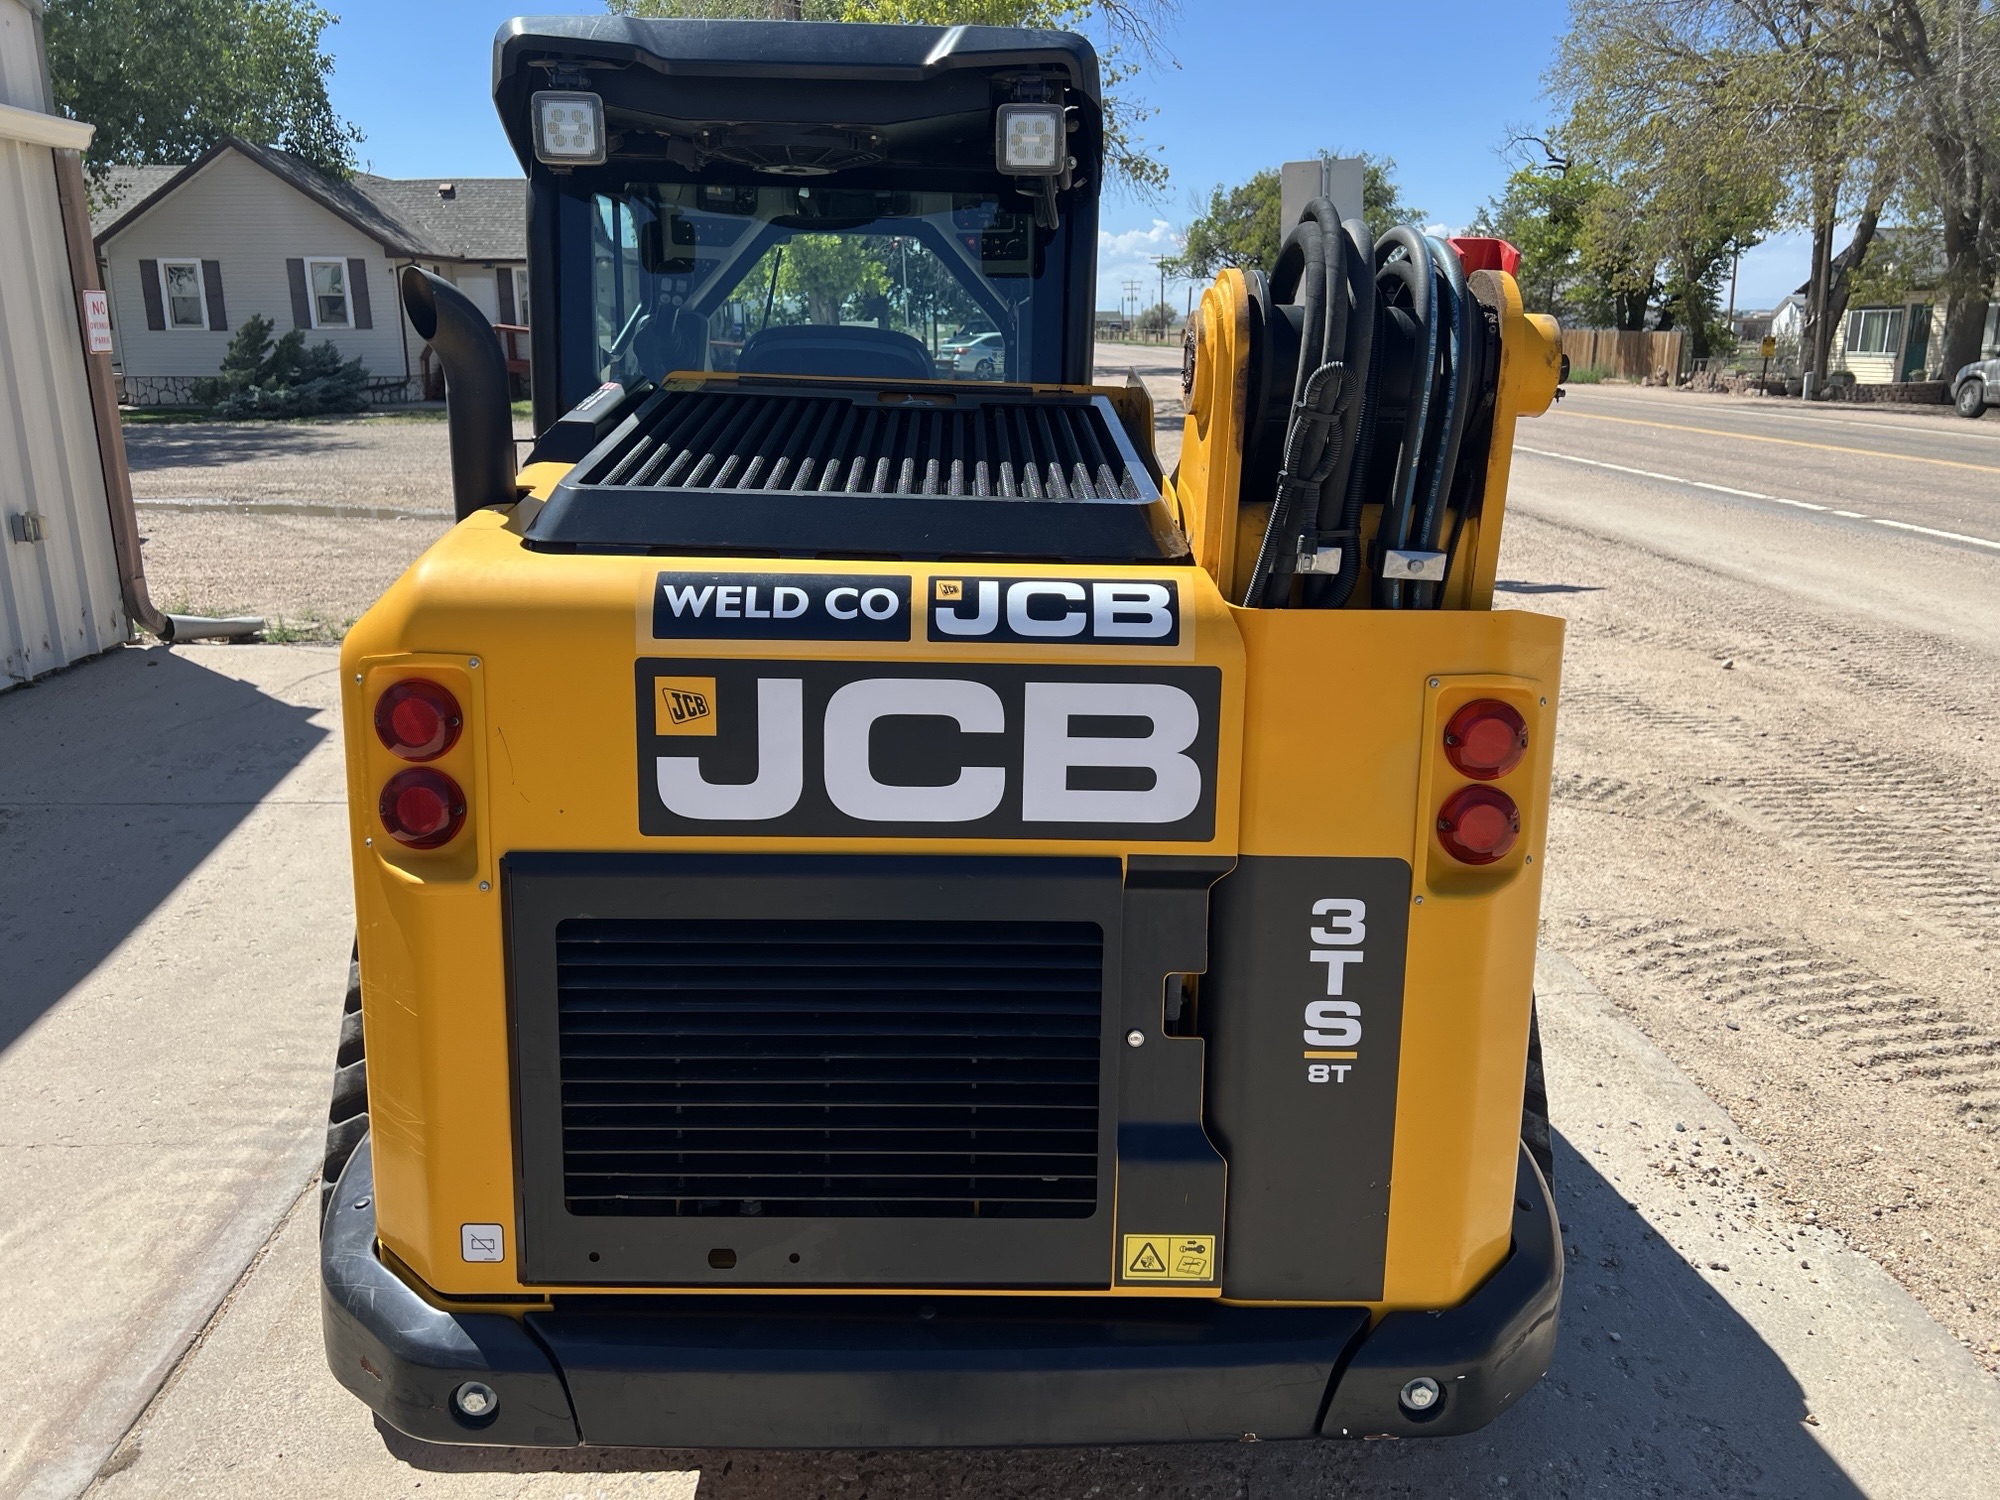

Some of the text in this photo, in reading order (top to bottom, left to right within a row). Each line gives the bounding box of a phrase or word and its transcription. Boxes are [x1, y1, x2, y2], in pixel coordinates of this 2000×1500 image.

[92, 301, 106, 315] NO
[663, 585, 900, 620] WELD CO
[935, 581, 1173, 638] JCB
[671, 691, 707, 720] JCB
[656, 678, 1202, 823] JCB
[1308, 1064, 1352, 1083] 8T
